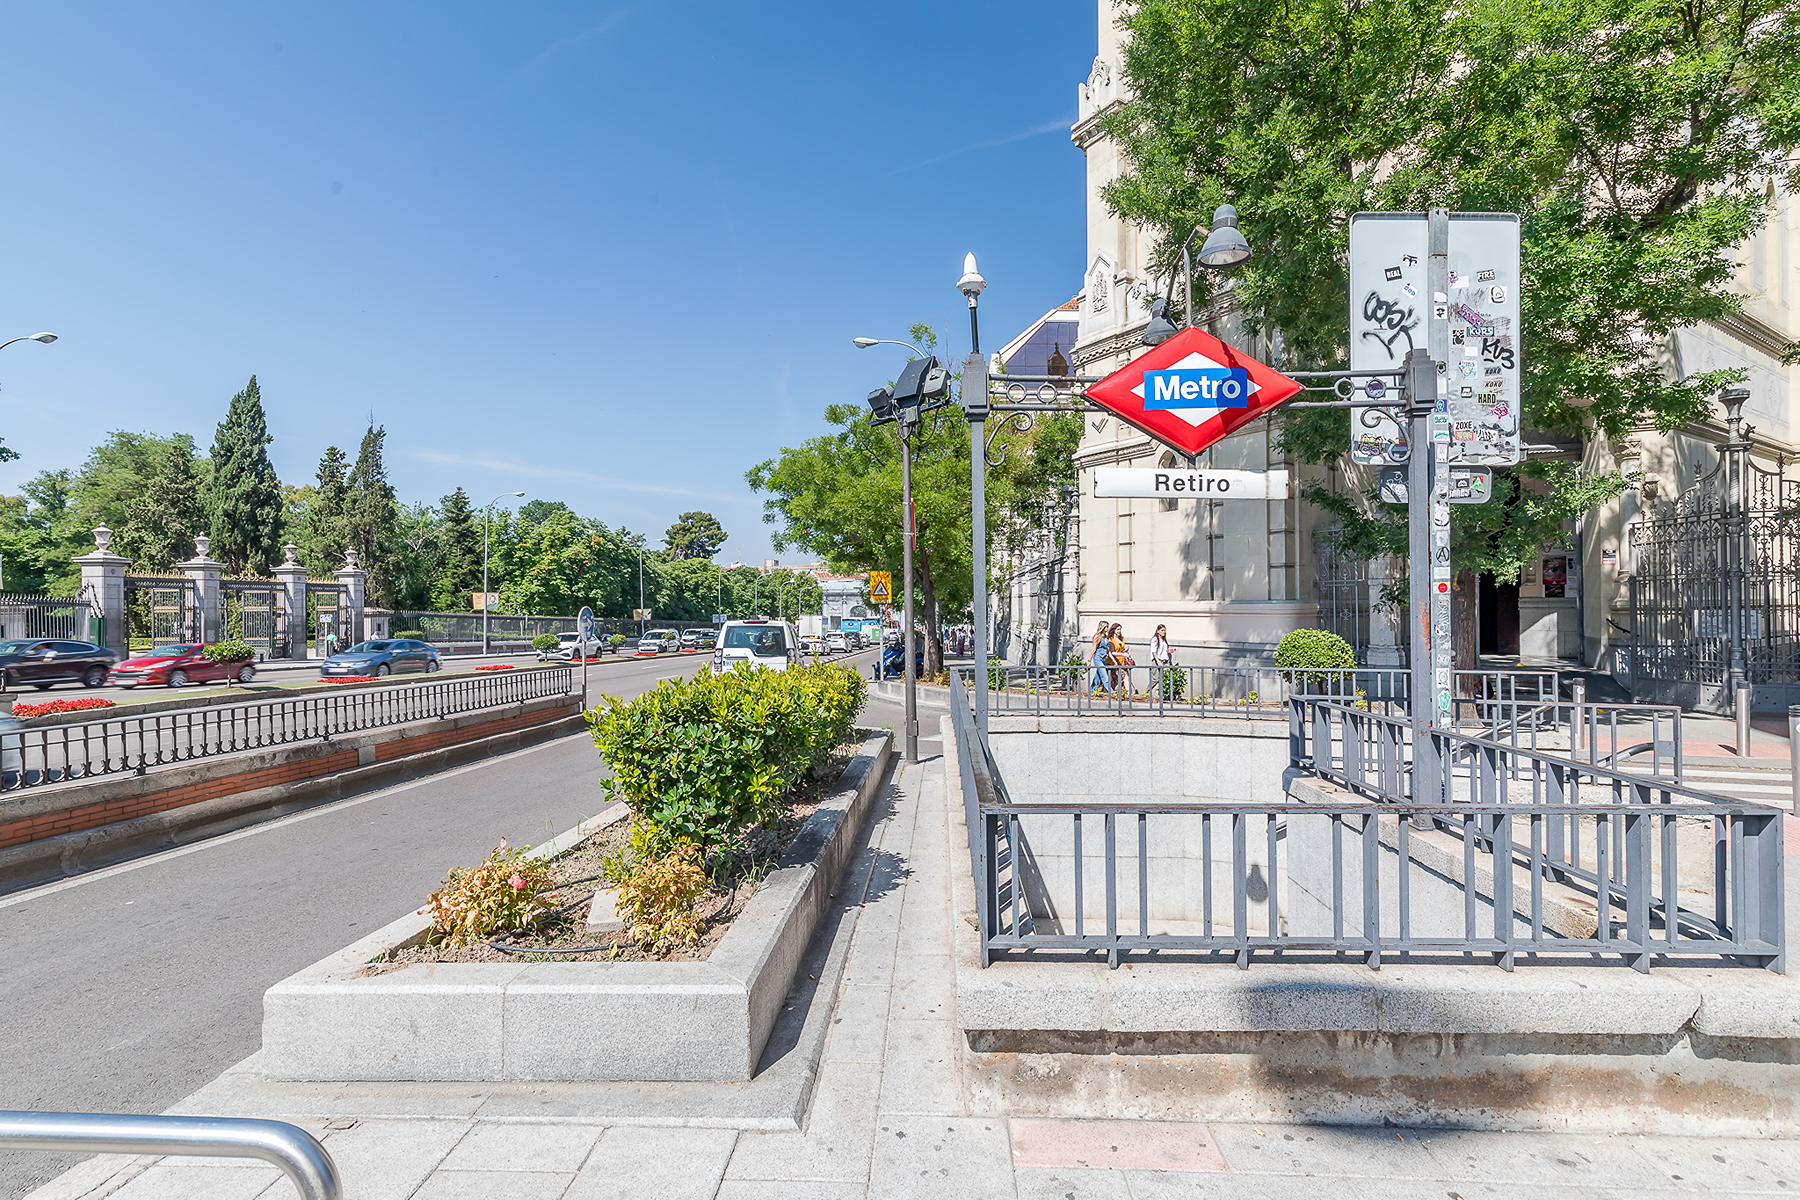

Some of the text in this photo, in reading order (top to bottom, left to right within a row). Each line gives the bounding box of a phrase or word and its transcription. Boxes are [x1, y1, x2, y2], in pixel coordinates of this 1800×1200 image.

[1153, 375, 1241, 401] Metro
[1477, 393, 1496, 404] HARD
[1154, 473, 1231, 492] Retiro
